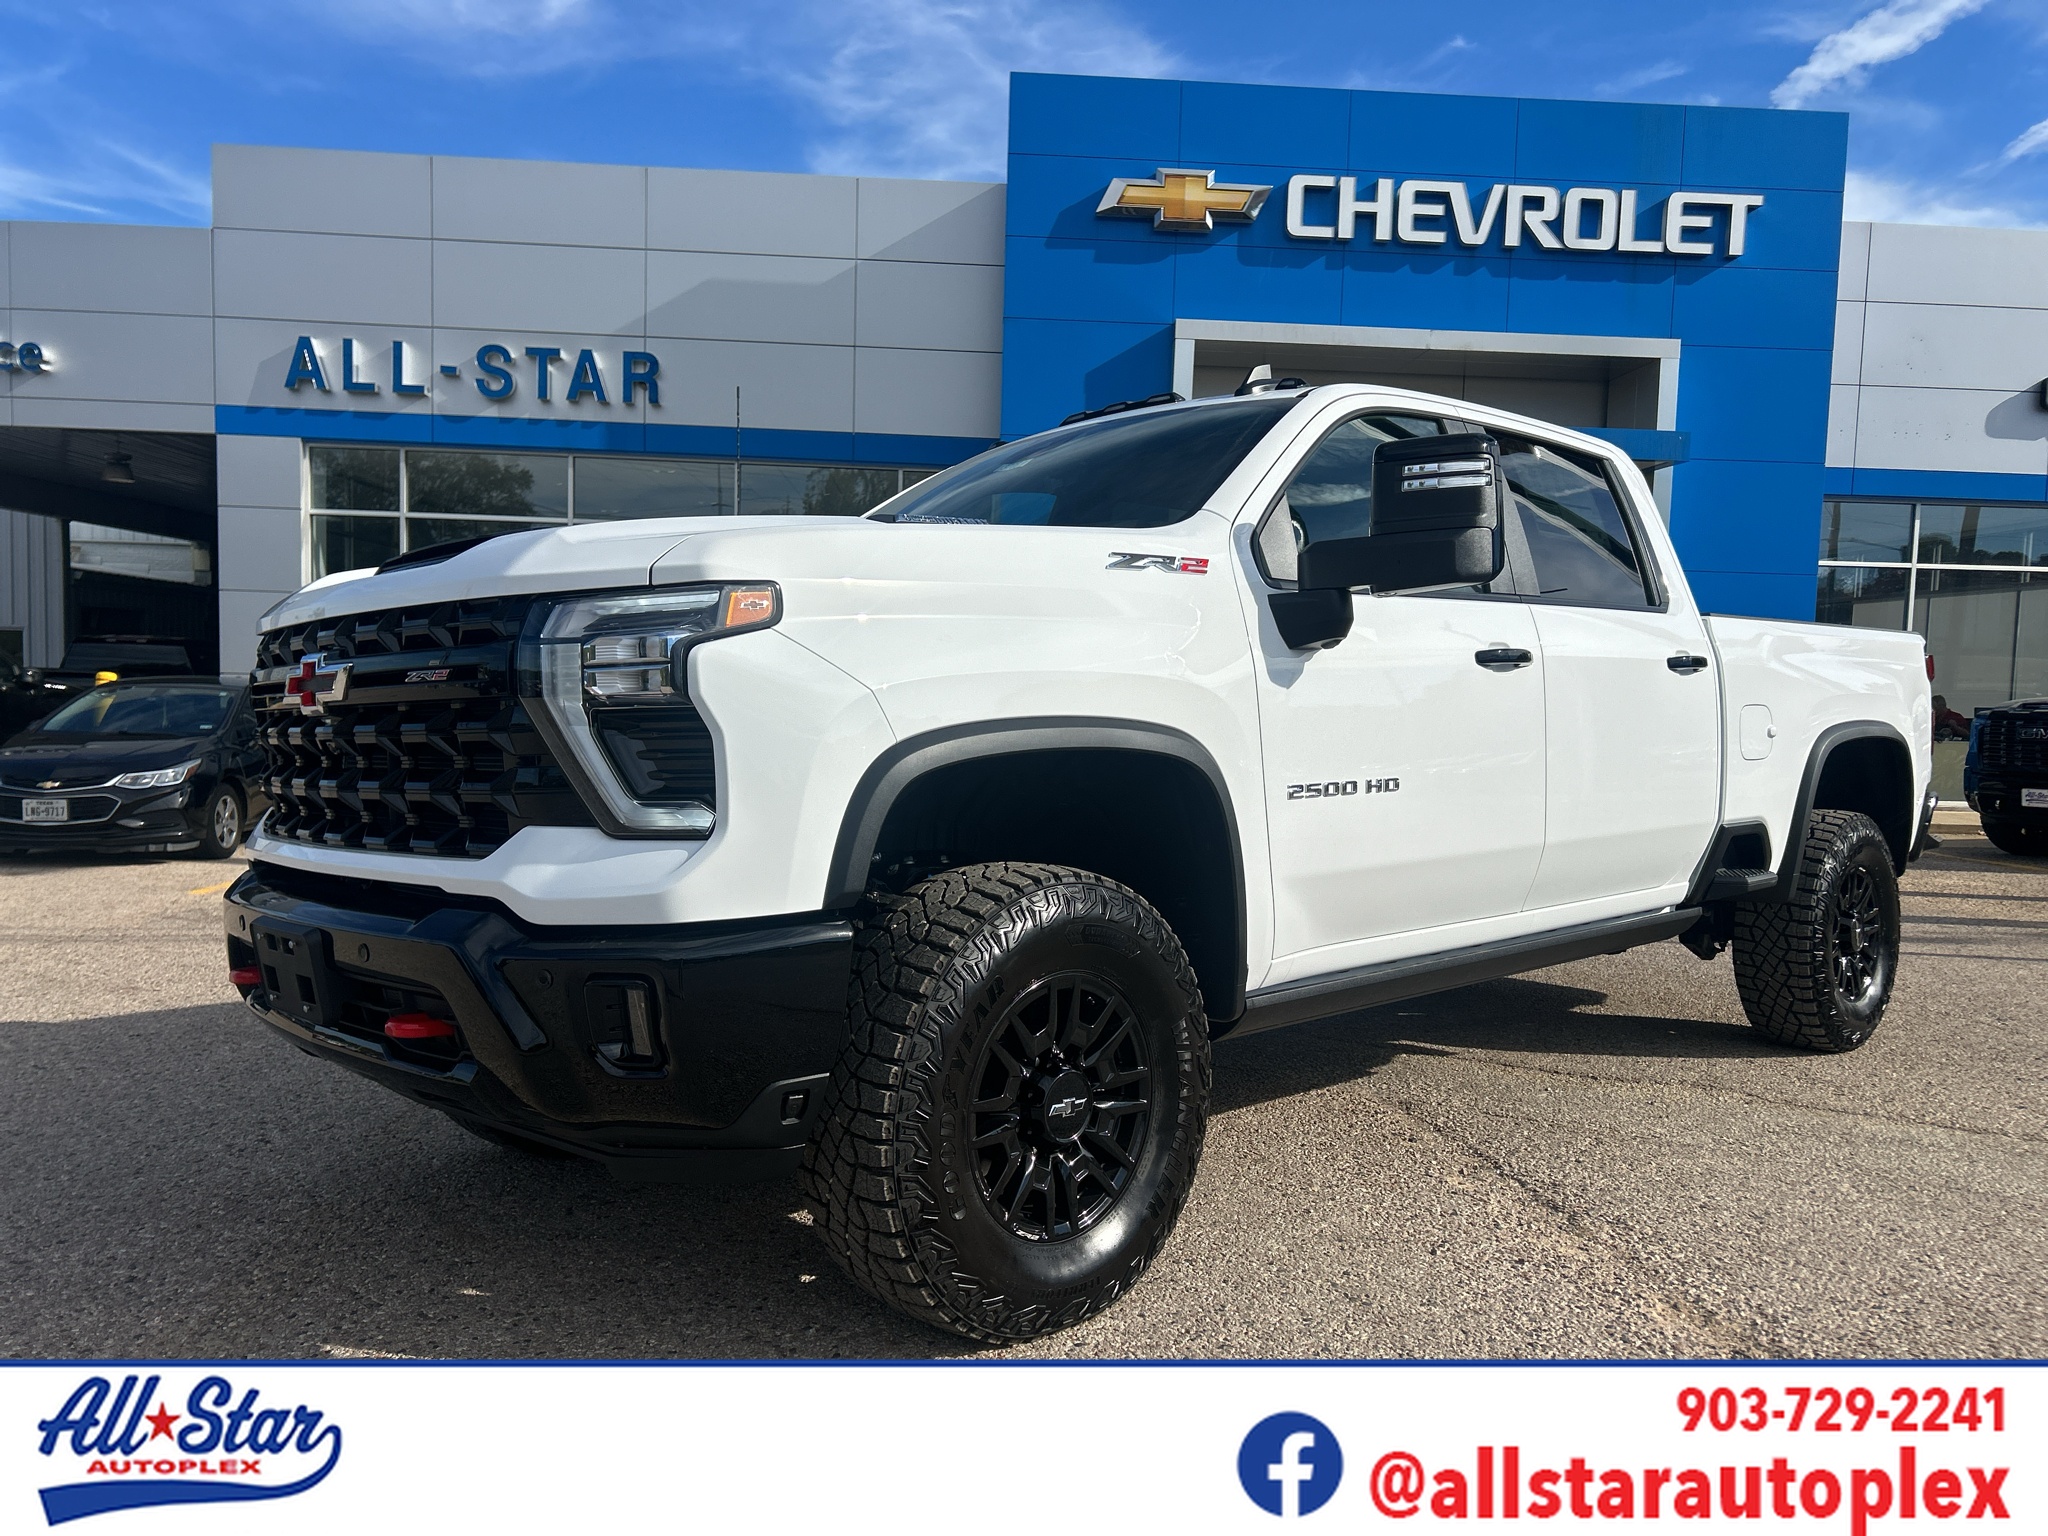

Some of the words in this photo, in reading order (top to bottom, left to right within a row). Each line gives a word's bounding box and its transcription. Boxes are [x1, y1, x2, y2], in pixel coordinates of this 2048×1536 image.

[1286, 174, 1764, 257] CHEVROLET
[284, 336, 661, 405] ALL-STAR
[1105, 552, 1209, 576] ZR2
[405, 669, 450, 682] ZR2
[1287, 783, 1358, 800] 2500
[1365, 777, 1400, 794] HD
[1146, 1016, 1195, 1220] WRANGLER
